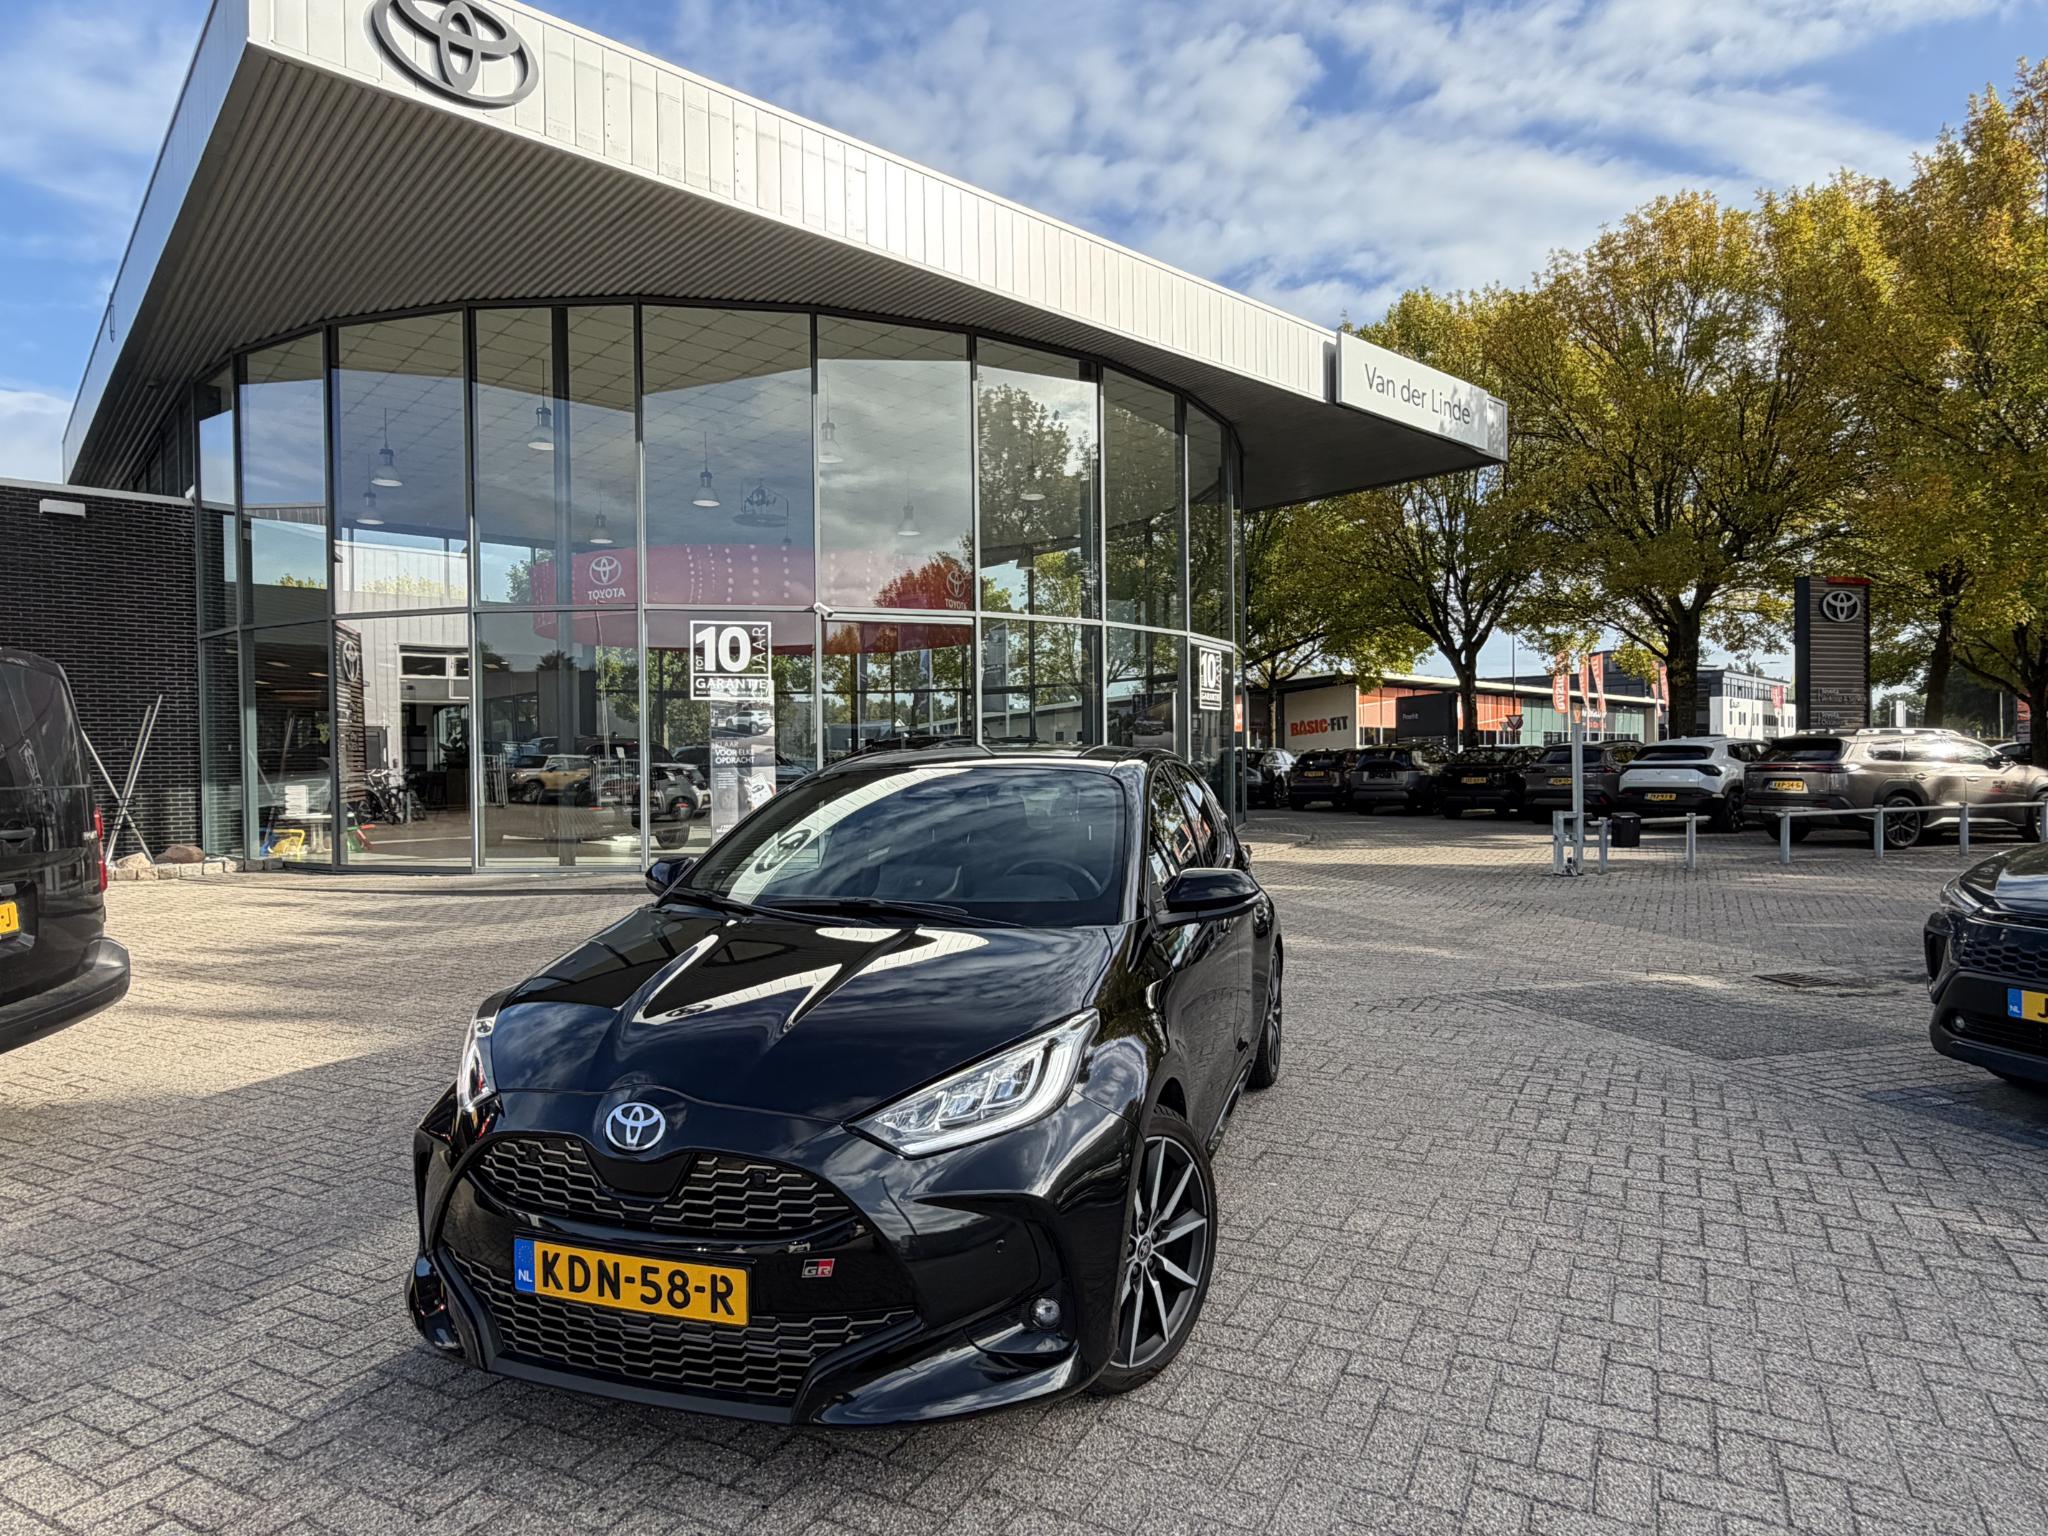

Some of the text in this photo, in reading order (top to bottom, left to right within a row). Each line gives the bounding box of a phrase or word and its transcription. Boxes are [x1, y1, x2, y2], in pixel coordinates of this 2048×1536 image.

[1365, 363, 1471, 425] Van der Linde
[588, 587, 626, 601] TOYOTA
[696, 626, 751, 672] 10
[752, 626, 767, 672] JAAR
[696, 678, 767, 689] GARANTIE
[714, 748, 738, 757] VOOR
[714, 756, 756, 765] OPDRACHT
[804, 1265, 832, 1276] GR
[518, 1250, 735, 1316] NL KDN-58-R
